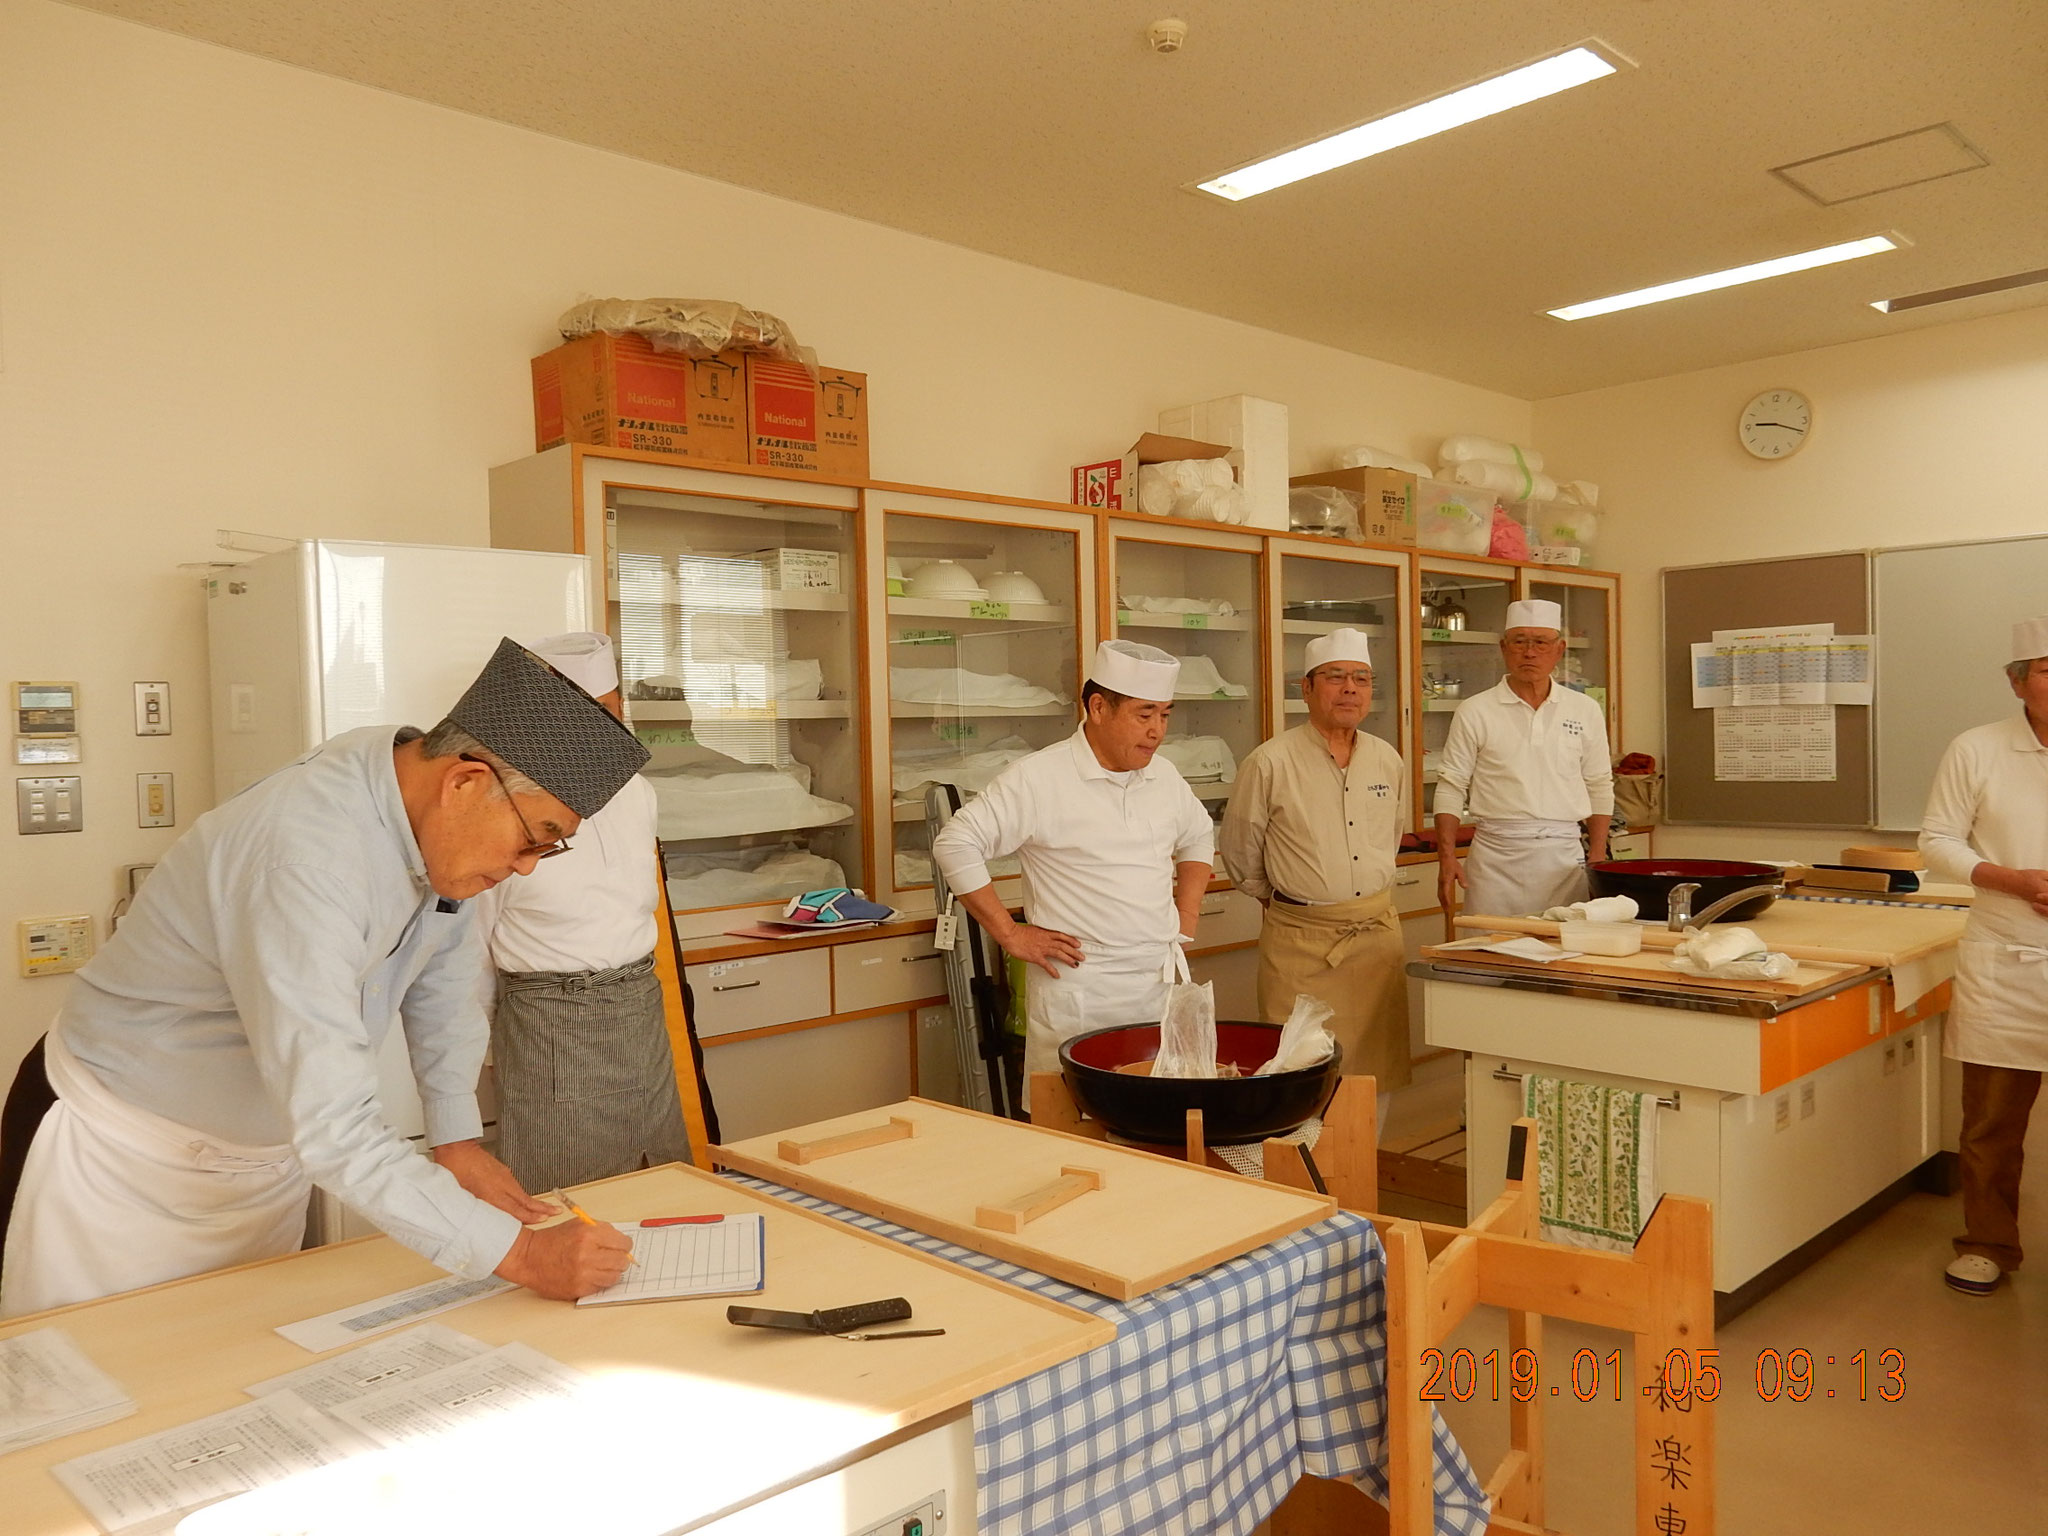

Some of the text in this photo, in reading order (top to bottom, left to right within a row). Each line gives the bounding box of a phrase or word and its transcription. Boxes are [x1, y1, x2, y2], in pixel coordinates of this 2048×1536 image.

[627, 392, 676, 409] National
[1772, 394, 1780, 403] 12
[764, 412, 807, 428] National
[1801, 416, 1808, 425] 3
[1745, 424, 1752, 432] 9
[633, 433, 673, 447] SR-330
[1773, 445, 1780, 454] 6
[769, 450, 804, 463] SR-330
